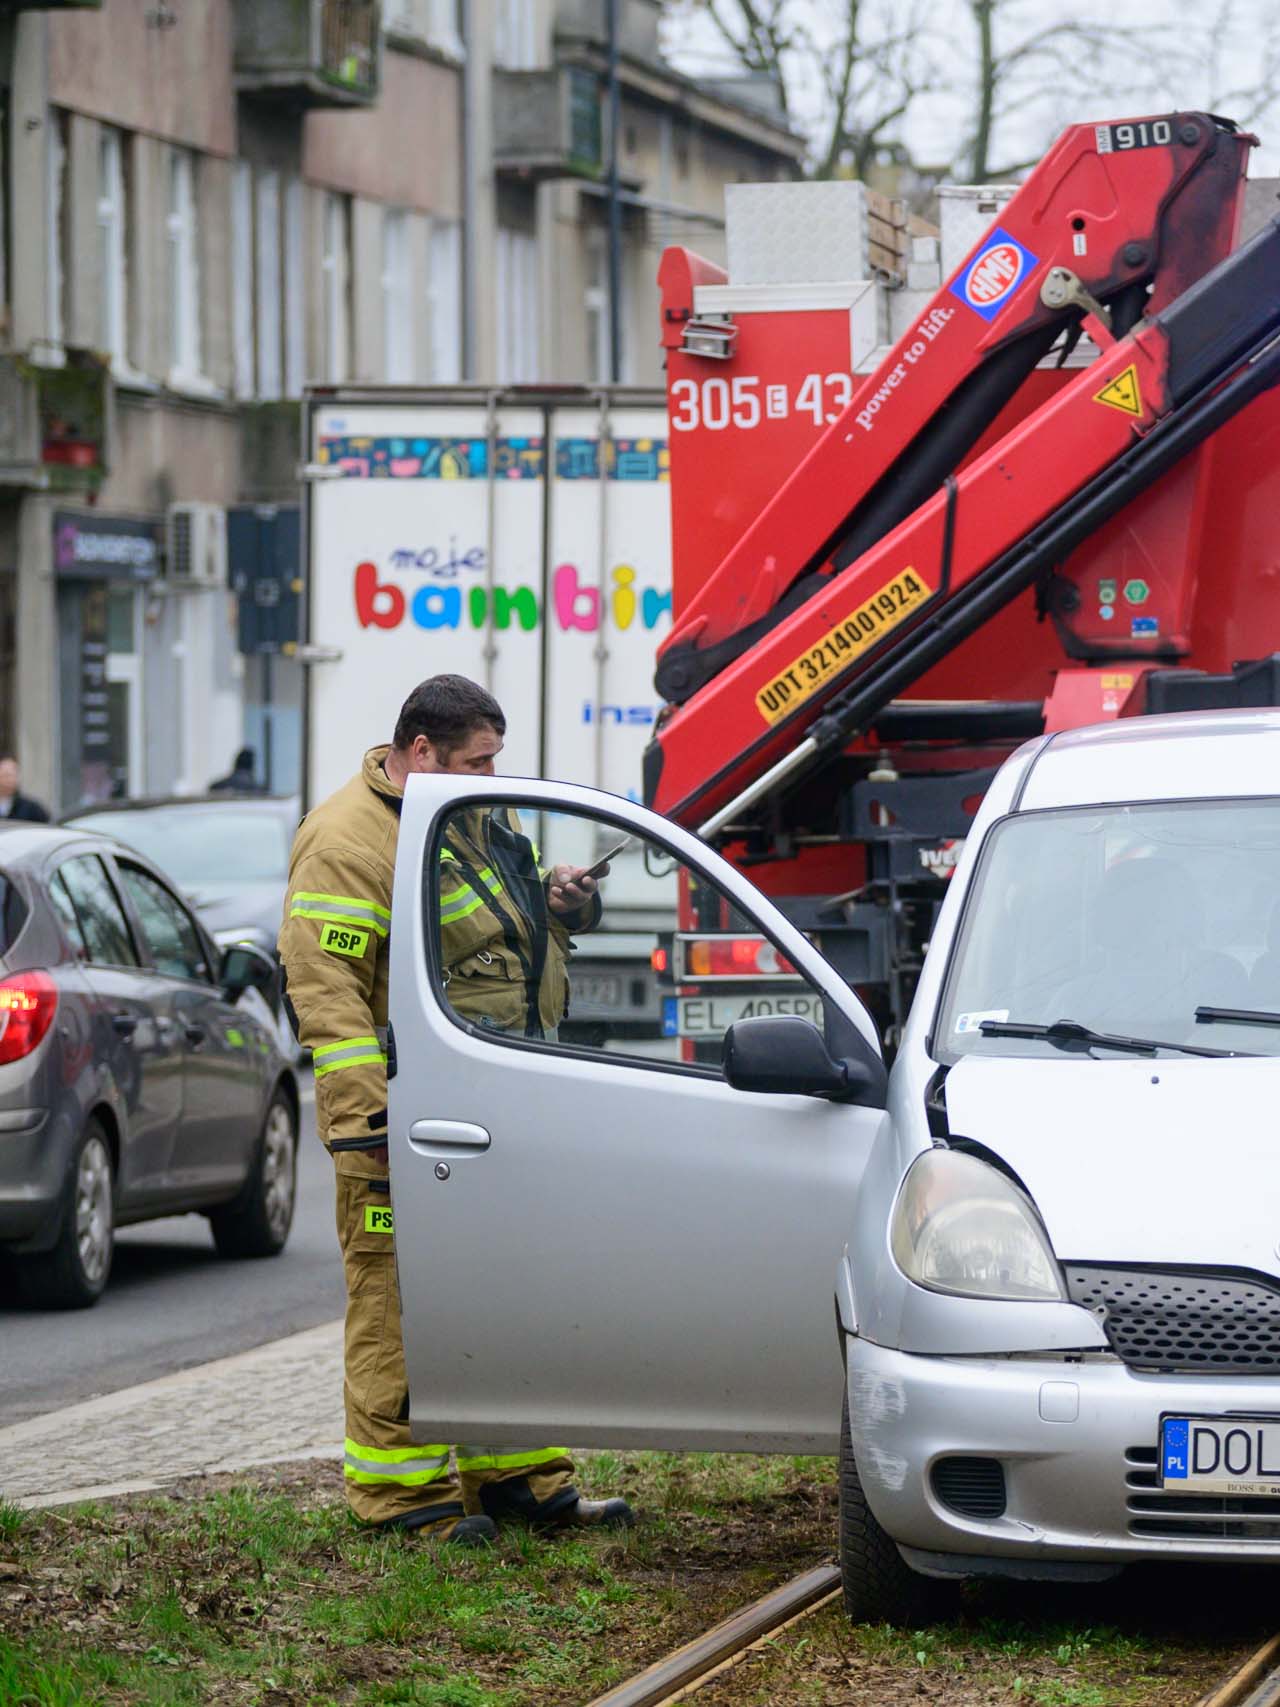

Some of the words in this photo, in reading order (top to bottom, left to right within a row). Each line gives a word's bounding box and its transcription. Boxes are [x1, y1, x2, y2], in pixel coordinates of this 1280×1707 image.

[1116, 121, 1171, 149] 910
[971, 248, 1016, 300] HMF
[855, 364, 907, 431] power
[904, 343, 926, 364] to
[917, 305, 956, 342] lift.
[671, 376, 760, 431] 305
[767, 385, 788, 418] E
[795, 373, 852, 426] 43
[392, 536, 486, 578] moje
[800, 574, 921, 680] 3214001924
[326, 929, 362, 952] PSP
[682, 1001, 726, 1031] EL
[1167, 1457, 1185, 1470] PL
[1227, 1483, 1255, 1492] BOSS
